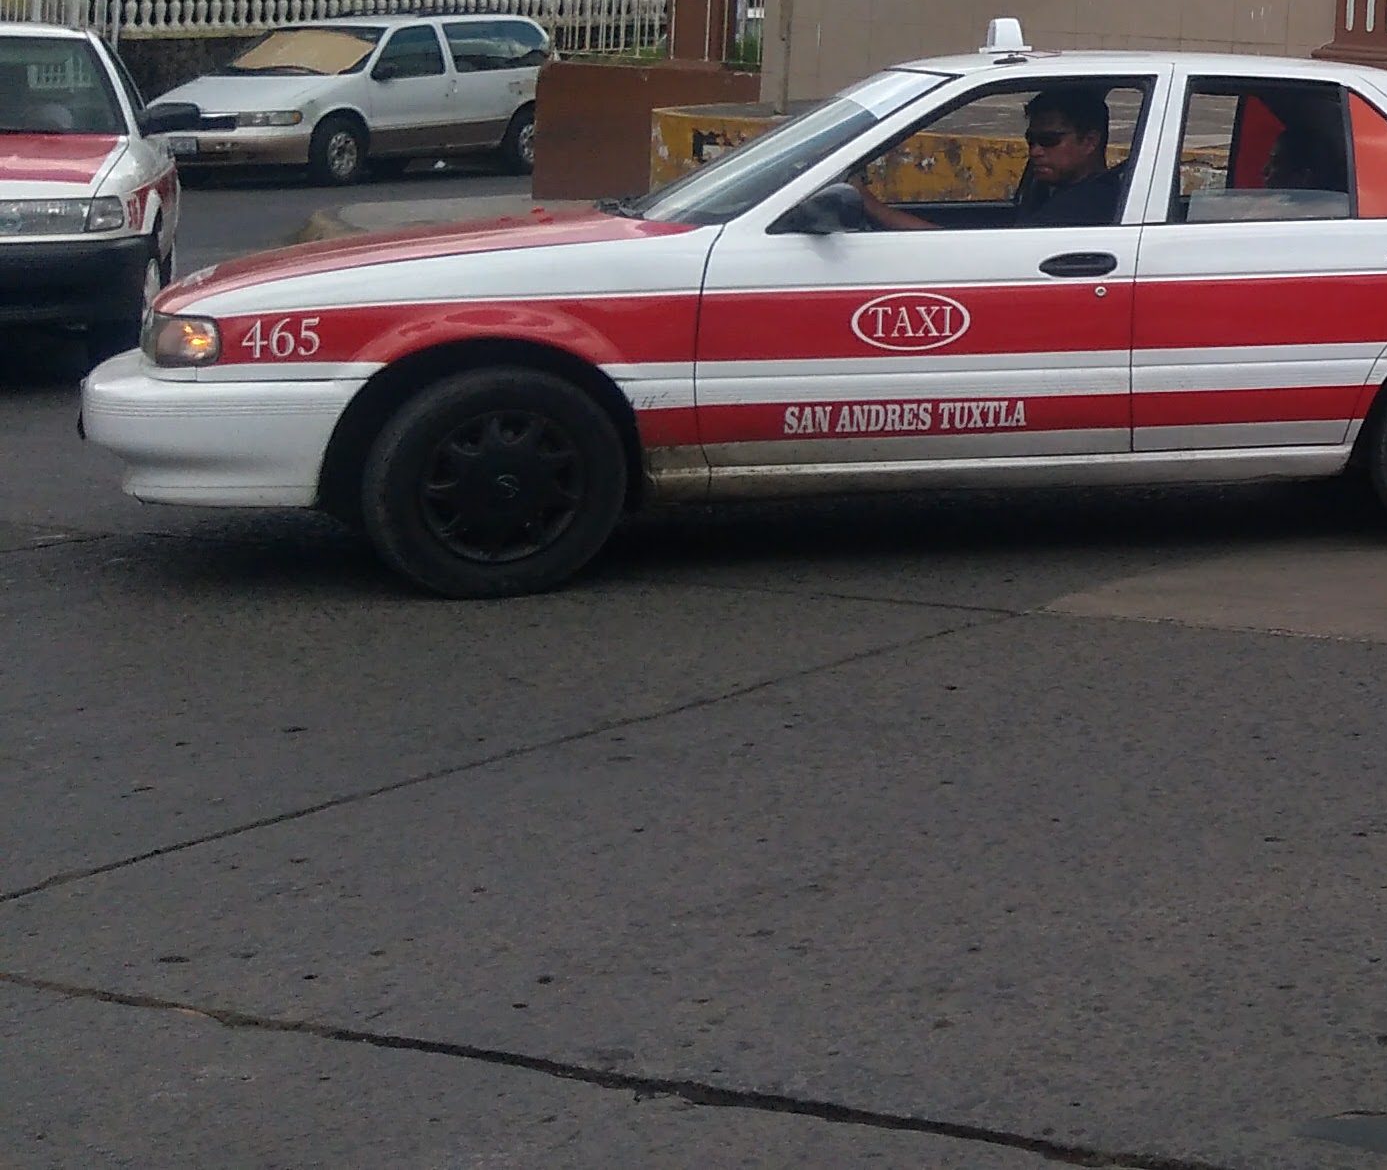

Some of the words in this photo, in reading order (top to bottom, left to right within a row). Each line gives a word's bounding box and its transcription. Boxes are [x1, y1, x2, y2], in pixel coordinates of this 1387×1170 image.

[241, 316, 320, 358] 465
[868, 306, 953, 338] TAXI
[784, 406, 831, 434] SAN
[835, 402, 933, 433] ANDRES
[938, 400, 1028, 429] TUXTLA
